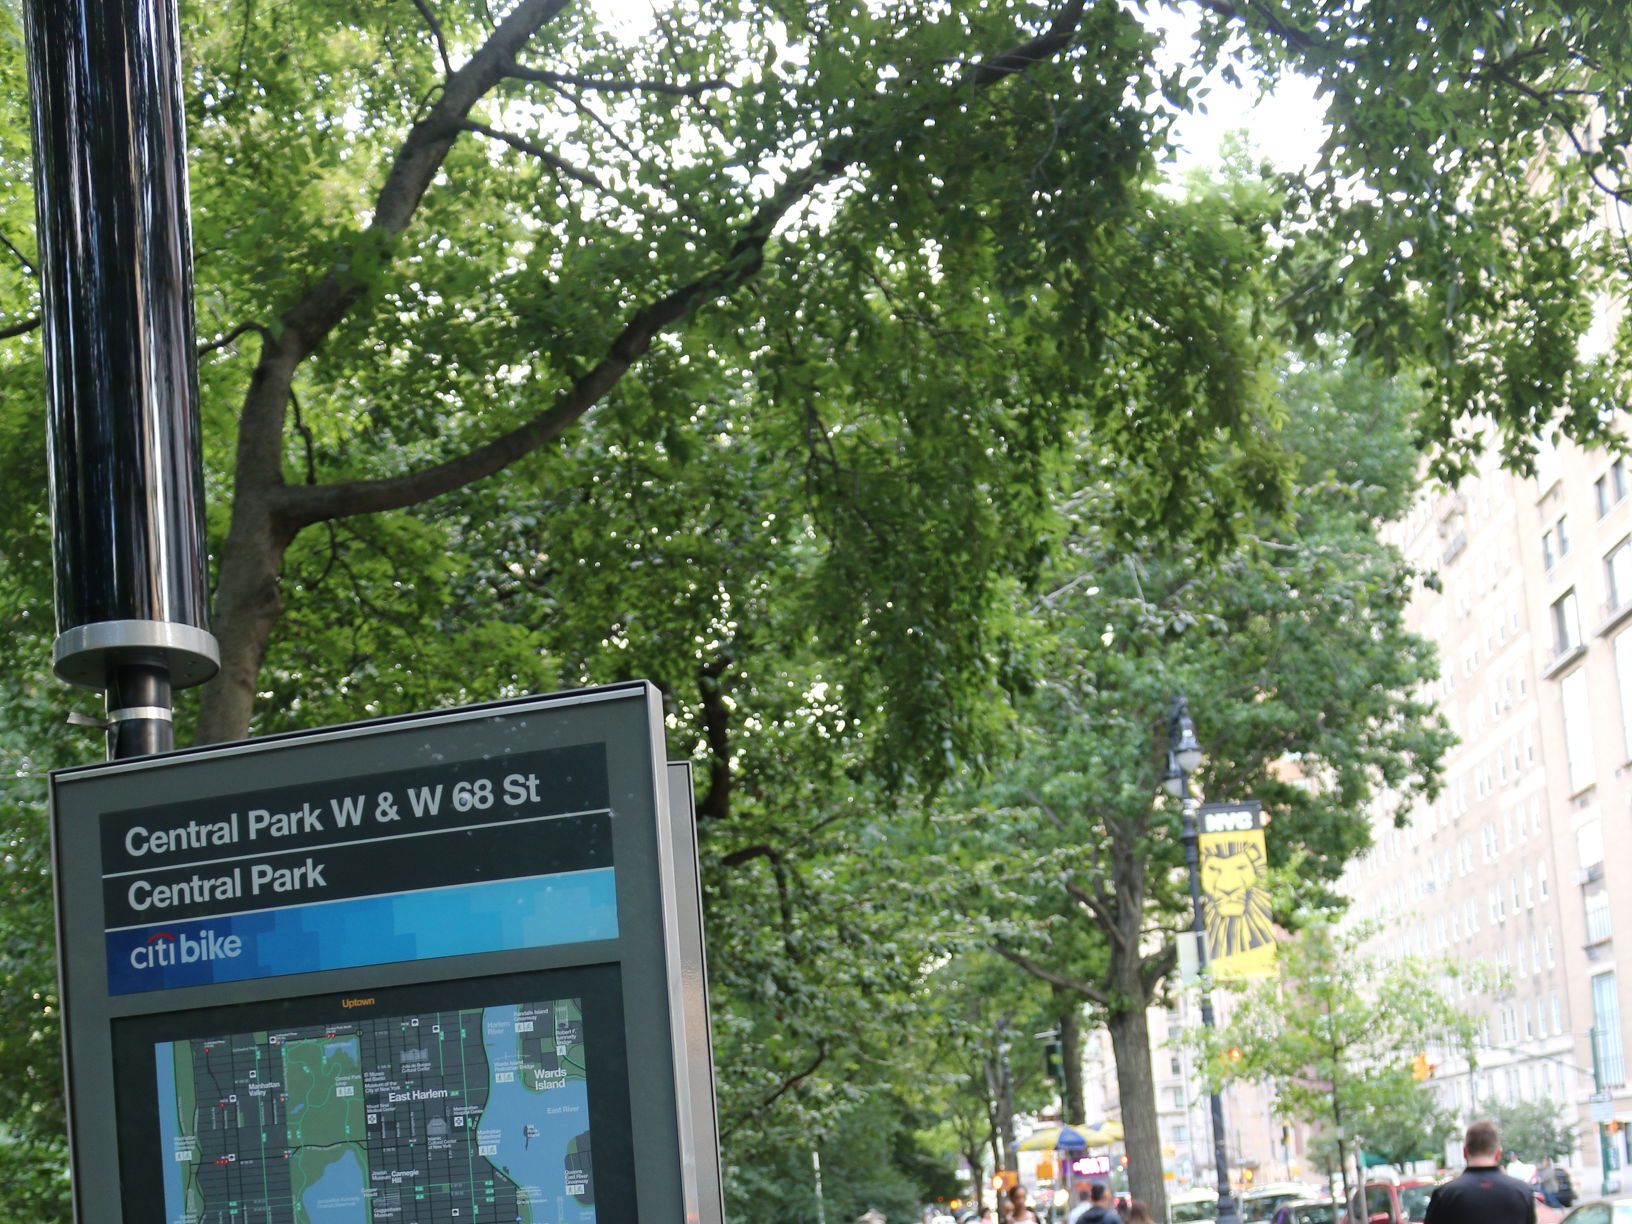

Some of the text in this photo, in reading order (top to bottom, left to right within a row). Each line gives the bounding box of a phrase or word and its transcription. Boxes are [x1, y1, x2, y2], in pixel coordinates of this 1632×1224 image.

[125, 773, 540, 857] Central Park W & W 68 St
[129, 858, 327, 911] Central Park
[342, 998, 375, 1008] Uptown
[534, 1068, 566, 1079] Wards
[535, 1079, 565, 1090] Island
[389, 1089, 447, 1102] East Harlem
[391, 1169, 419, 1178] Carnegie
